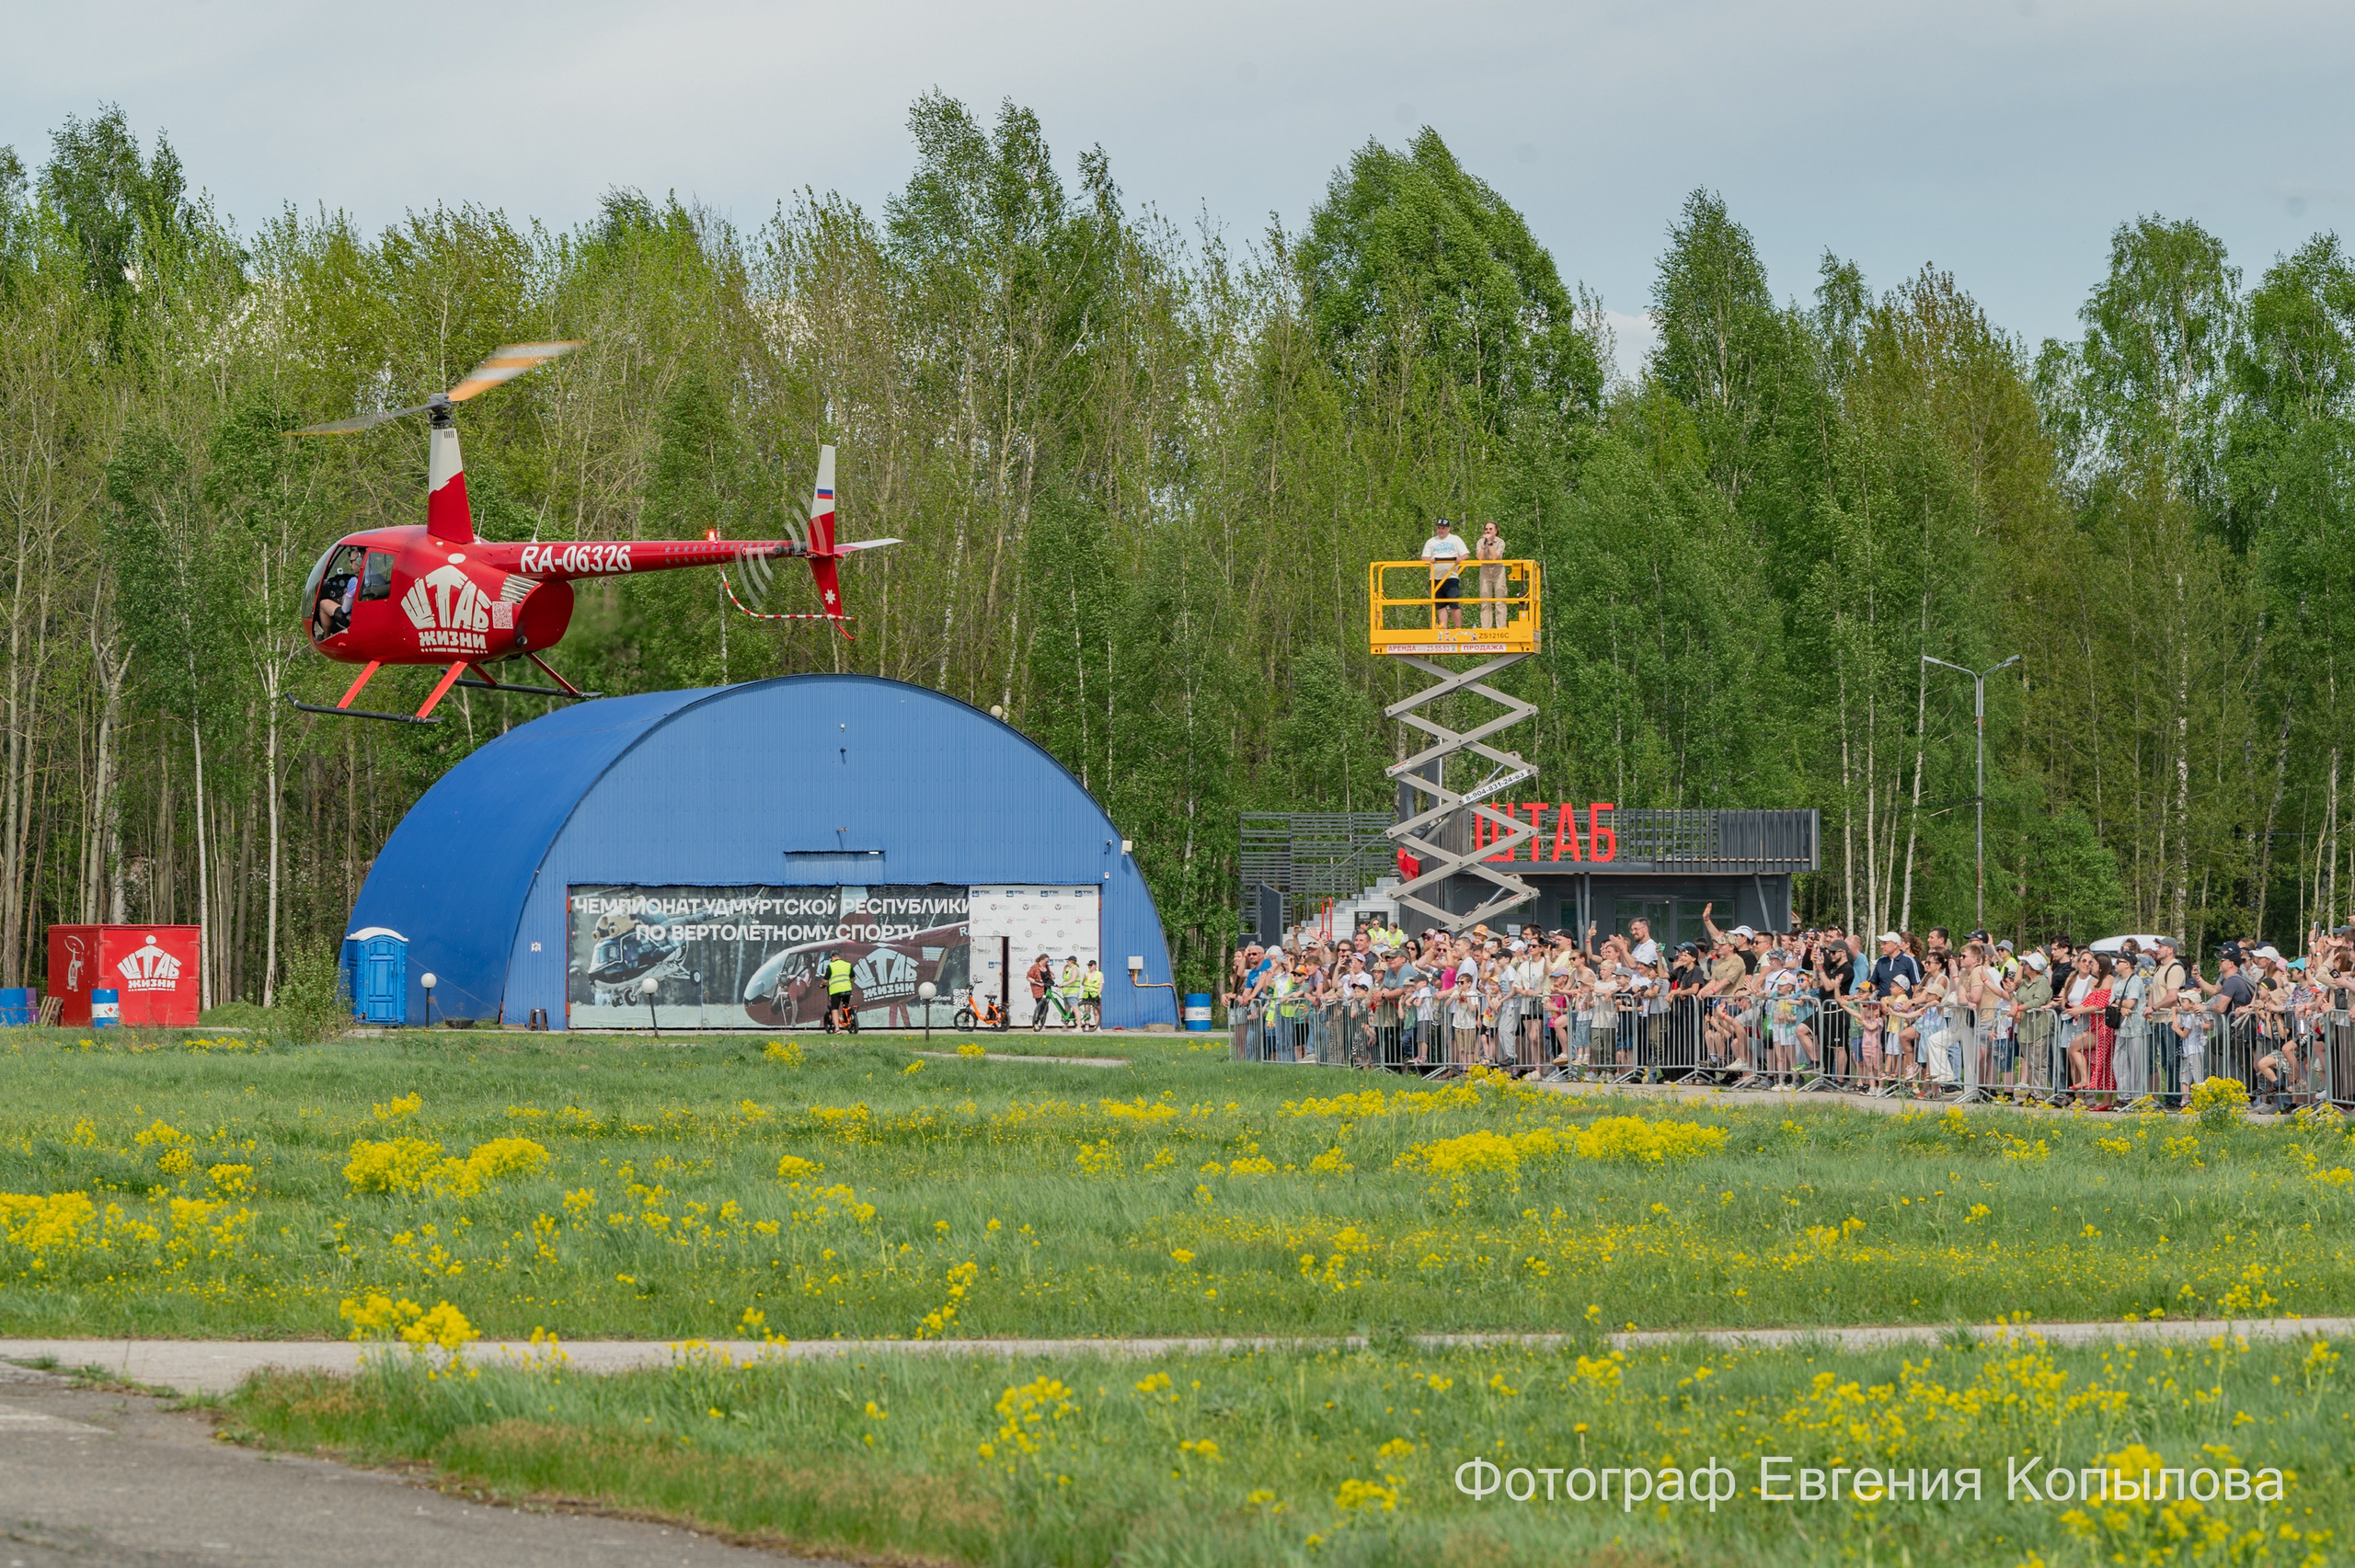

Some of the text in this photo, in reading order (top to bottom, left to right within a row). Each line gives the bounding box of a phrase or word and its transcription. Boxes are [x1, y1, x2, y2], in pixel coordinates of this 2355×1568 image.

[521, 544, 632, 572] RA-06326
[400, 565, 492, 633] ШТАБ
[418, 631, 488, 649] ЖИЗНИ
[1475, 803, 1616, 863] ШТАБ
[574, 898, 703, 915] ЧЕМПИОНАТ
[842, 898, 970, 914] РЕСПУБЛИКИ
[636, 920, 919, 942] ПО ВЕРТОЛЁТНОМУ СПОРТУ
[117, 944, 182, 979] ШТАБ
[853, 948, 919, 989] ШТАБ
[128, 979, 176, 989] ЖИЗНИ
[862, 982, 915, 999] ЖИЗНИ
